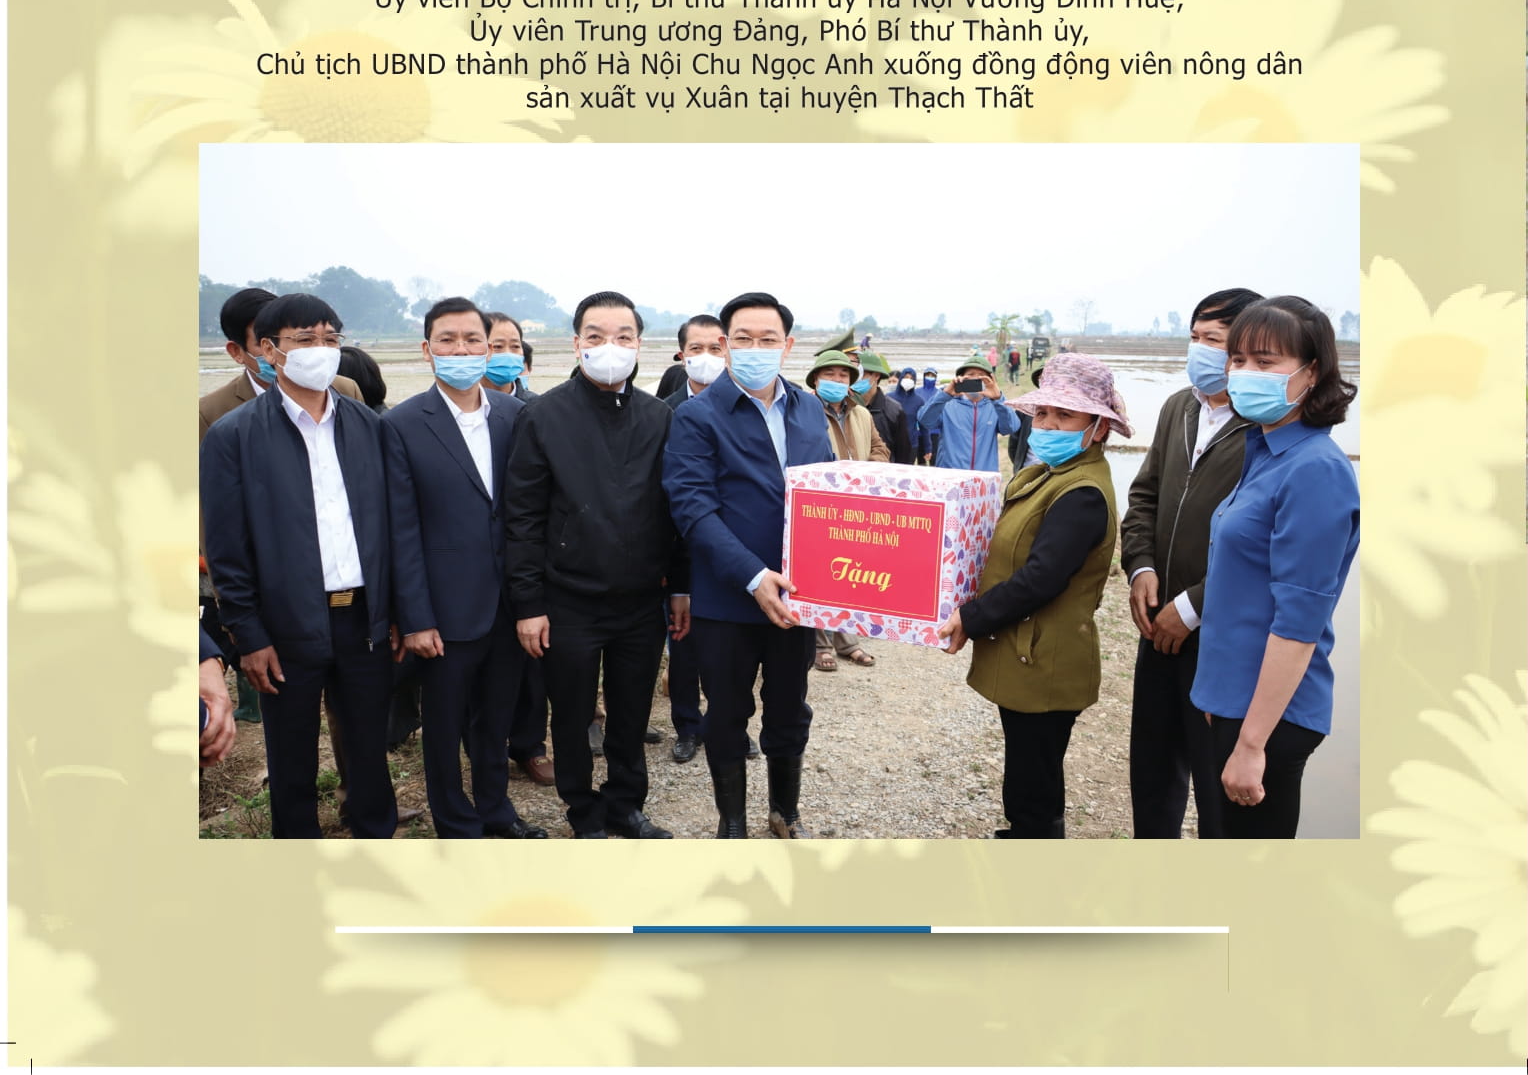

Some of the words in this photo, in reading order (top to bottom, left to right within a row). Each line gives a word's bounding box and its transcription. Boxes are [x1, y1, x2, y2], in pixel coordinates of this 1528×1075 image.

[471, 13, 502, 46] Ủy
[513, 18, 563, 41] viên
[575, 20, 645, 46] Trung
[659, 21, 721, 46] ương
[733, 18, 807, 46] Đảng,
[821, 18, 866, 41] Phó
[879, 18, 900, 40] Bí
[911, 20, 954, 41] thư
[963, 18, 1041, 41] Thành
[1055, 18, 1088, 46] ủy,
[258, 52, 304, 74] Chủ
[316, 53, 360, 79] tịch
[373, 54, 445, 74] UBND
[456, 51, 527, 74] thành
[541, 51, 587, 80] phố
[599, 51, 629, 74] Hà
[643, 52, 680, 79] Nội
[693, 53, 739, 74] Chu
[753, 54, 814, 80] Ngọc
[825, 53, 872, 74] Anh
[885, 51, 960, 80] xuống
[973, 51, 1034, 80] đồng
[1047, 51, 1108, 80] động
[1120, 51, 1171, 74] viên
[1184, 51, 1244, 80] nông
[1258, 52, 1301, 74] dân
[527, 85, 568, 108] sản
[581, 85, 635, 108] xuất
[646, 92, 674, 113] vụ
[687, 85, 747, 108] Xuân
[759, 87, 789, 112] tại
[802, 85, 876, 113] huyện
[888, 86, 964, 112] Thạch
[976, 85, 1033, 108] Thất
[830, 556, 893, 592] Tặng
